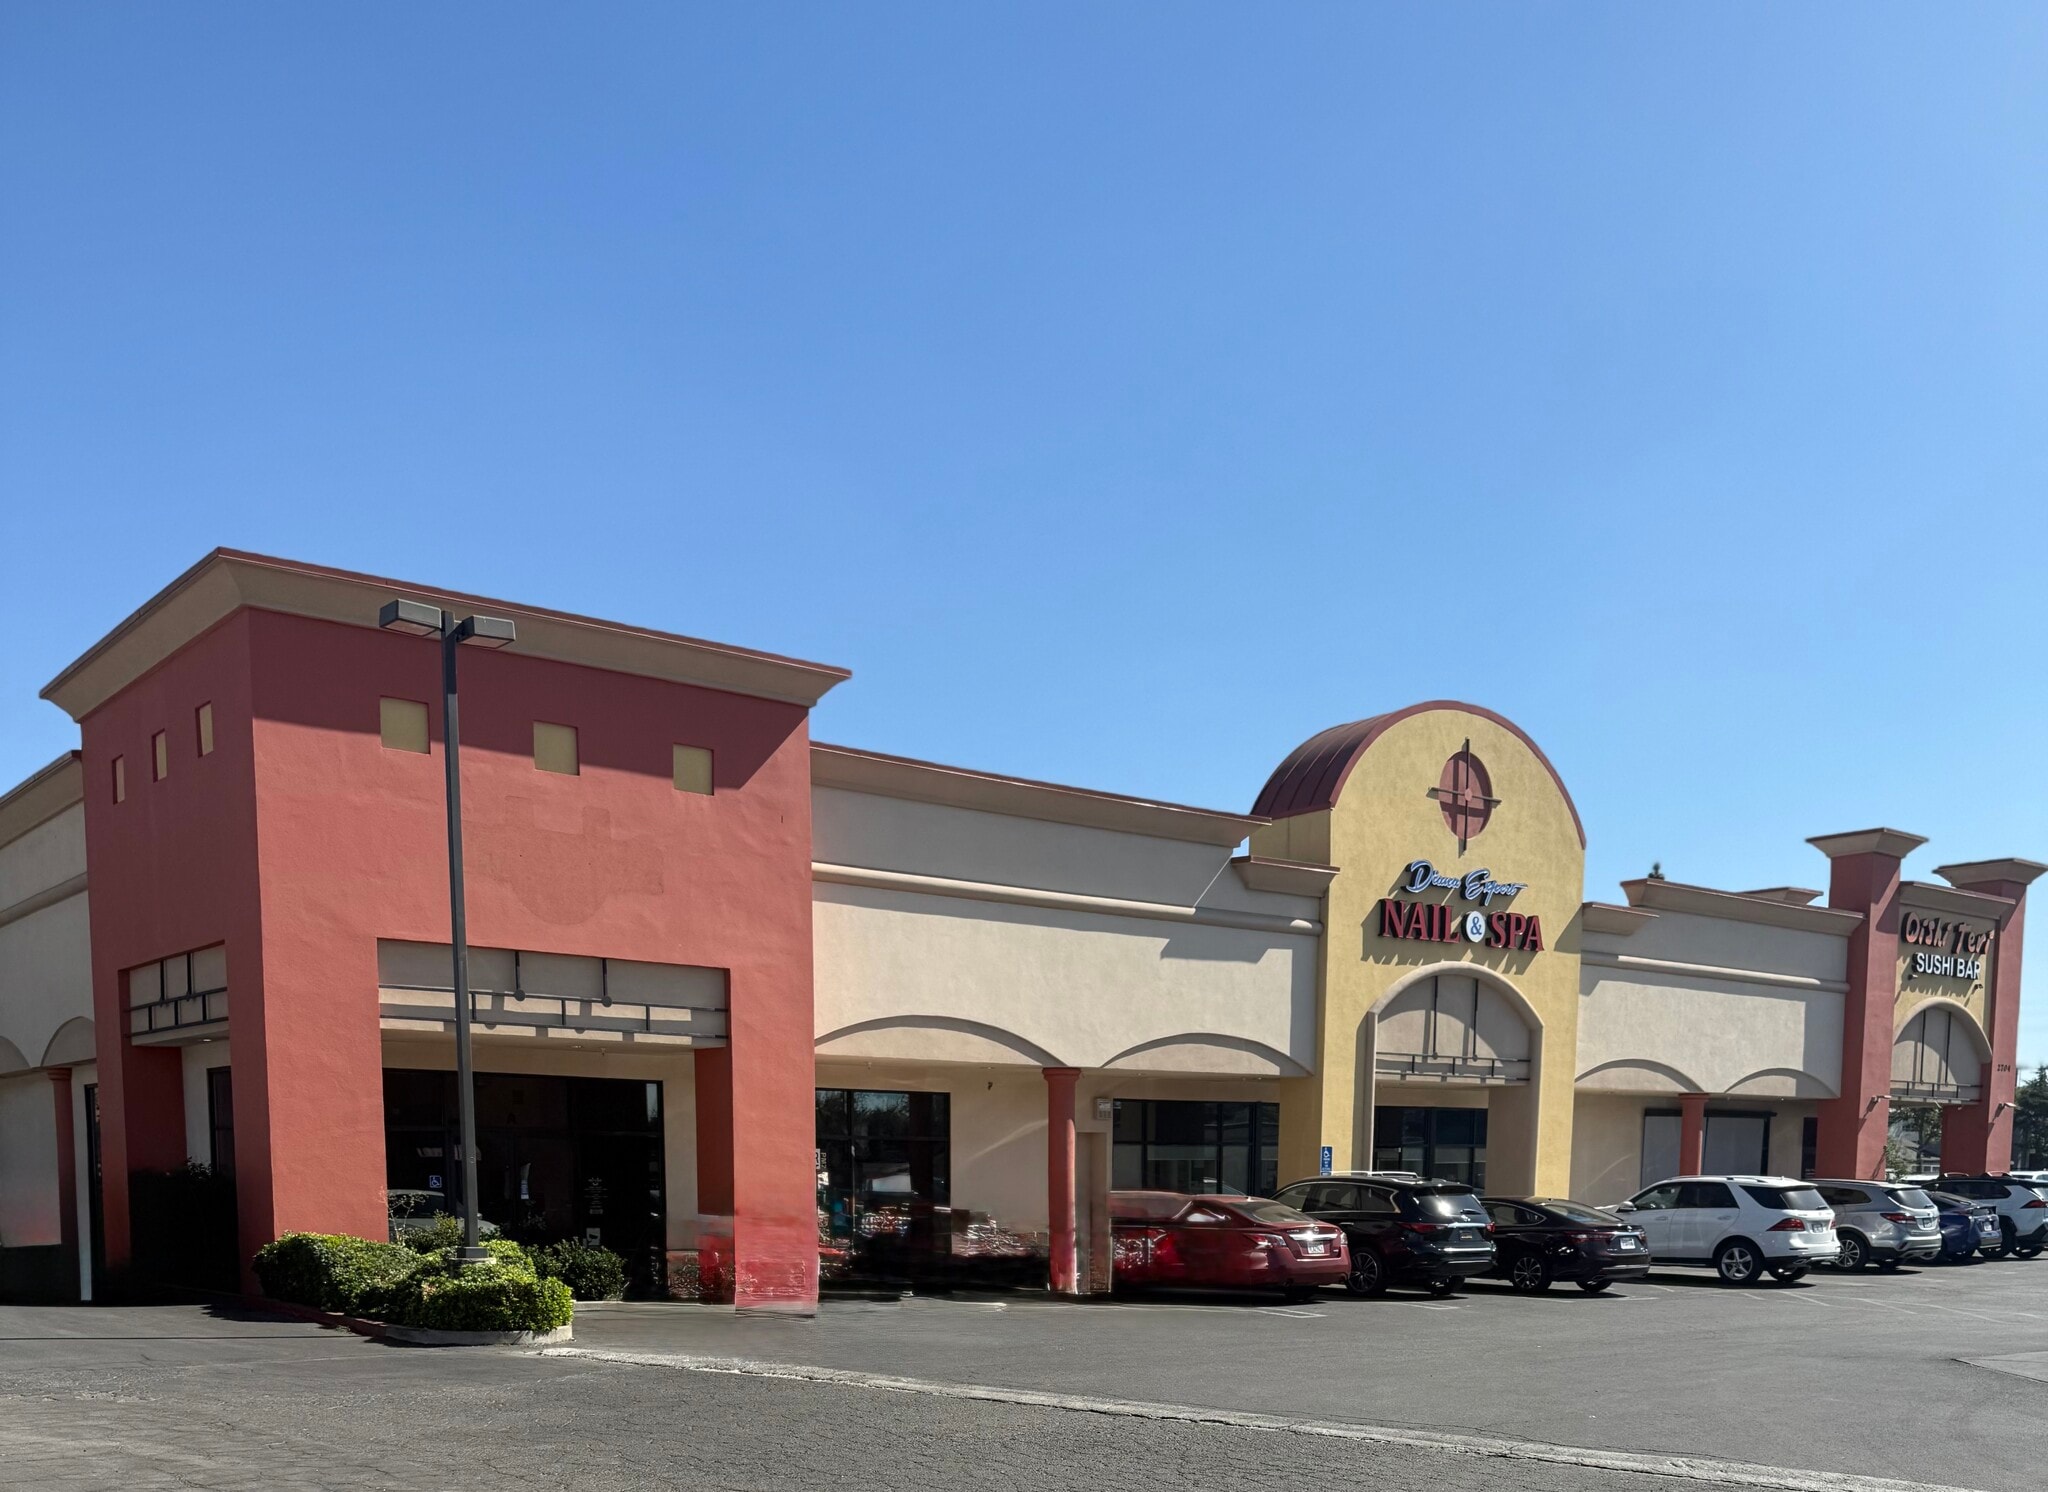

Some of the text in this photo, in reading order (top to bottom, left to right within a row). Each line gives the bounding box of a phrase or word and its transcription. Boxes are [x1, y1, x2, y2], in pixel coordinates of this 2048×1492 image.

[1381, 898, 1460, 943] NAIL
[1489, 911, 1544, 951] SPA
[1905, 911, 1995, 955] Oishi Teri
[1916, 952, 1981, 979] SUSHI BAR
